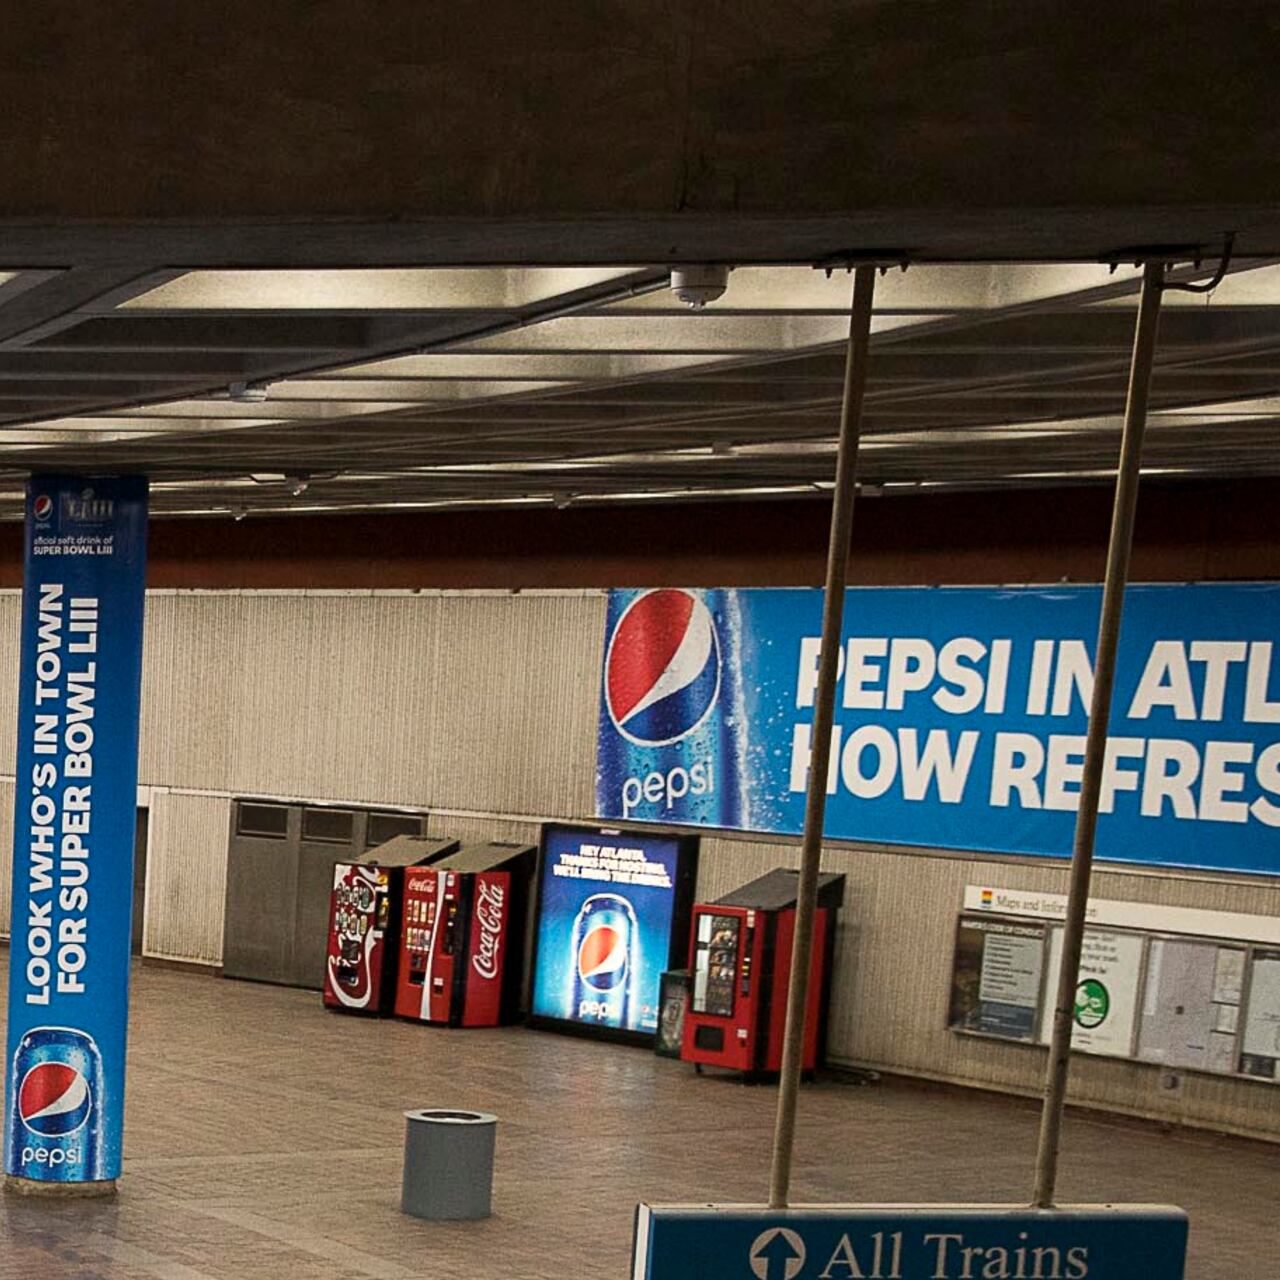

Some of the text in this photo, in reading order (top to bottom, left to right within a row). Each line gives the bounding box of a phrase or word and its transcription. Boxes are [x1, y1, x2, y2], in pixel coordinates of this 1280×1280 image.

[33, 545, 113, 555] SUPER BOWL LIII
[57, 535, 75, 545] soft
[76, 535, 101, 545] drink
[103, 535, 114, 545] of
[796, 637, 1012, 714] PEPSI
[26, 583, 63, 1005] LOOK WHO'S IN TOWN
[57, 598, 98, 993] FOR SUPER BOWL LIII
[622, 755, 714, 819] pepsi
[790, 723, 981, 804] HOW
[21, 1146, 81, 1166] pepsi
[818, 1231, 1090, 1280] All Trains
